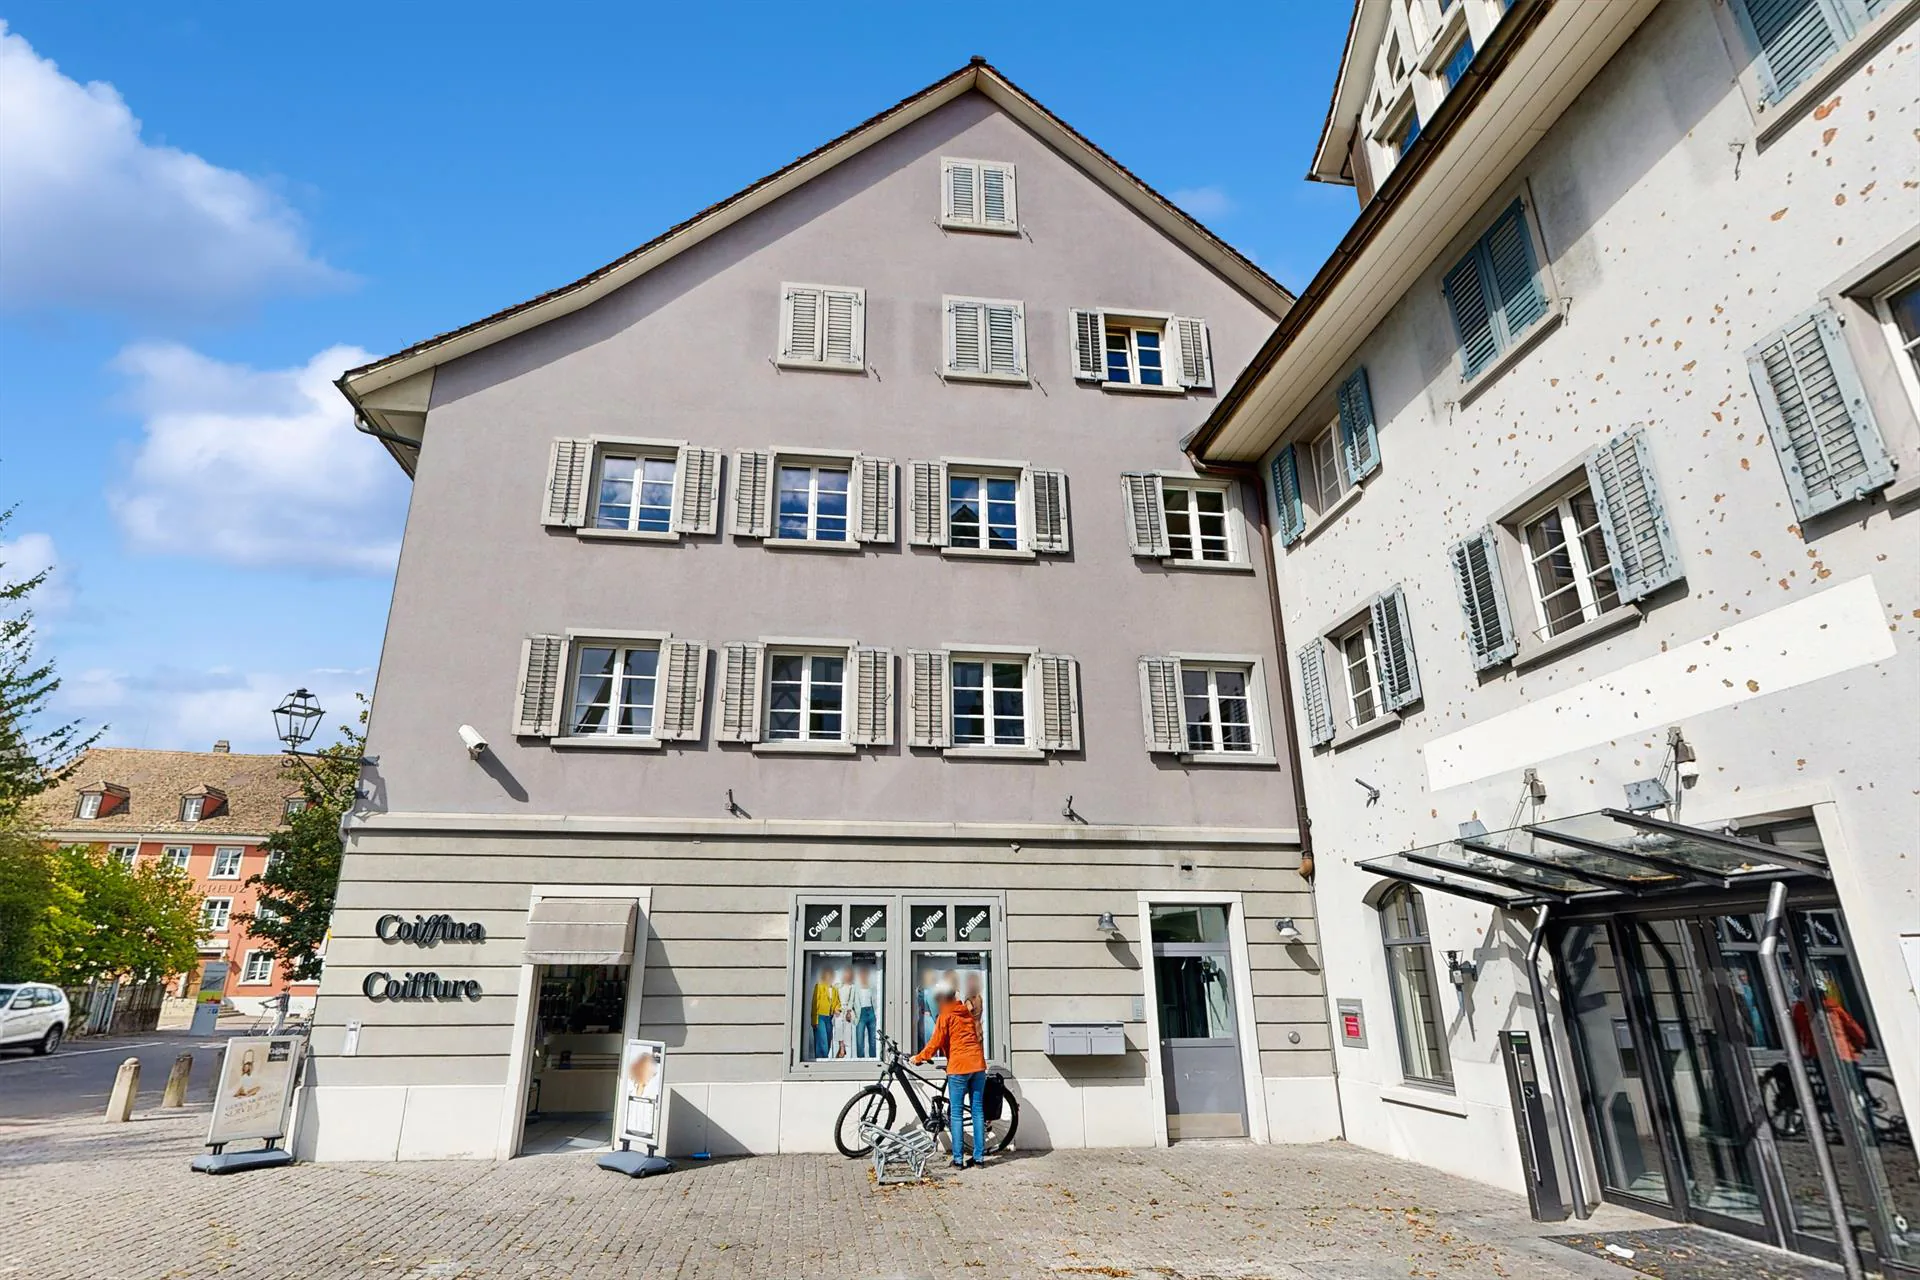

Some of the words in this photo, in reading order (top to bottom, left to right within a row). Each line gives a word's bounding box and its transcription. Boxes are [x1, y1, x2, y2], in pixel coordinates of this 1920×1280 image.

[196, 883, 248, 894] KREUZ
[375, 913, 487, 946] Coiffina
[808, 909, 840, 938] Coiffina
[853, 909, 884, 938] Coiffure
[914, 909, 944, 938] Coiffina
[958, 909, 987, 938] Coiffure
[362, 971, 484, 1001] Coiffure
